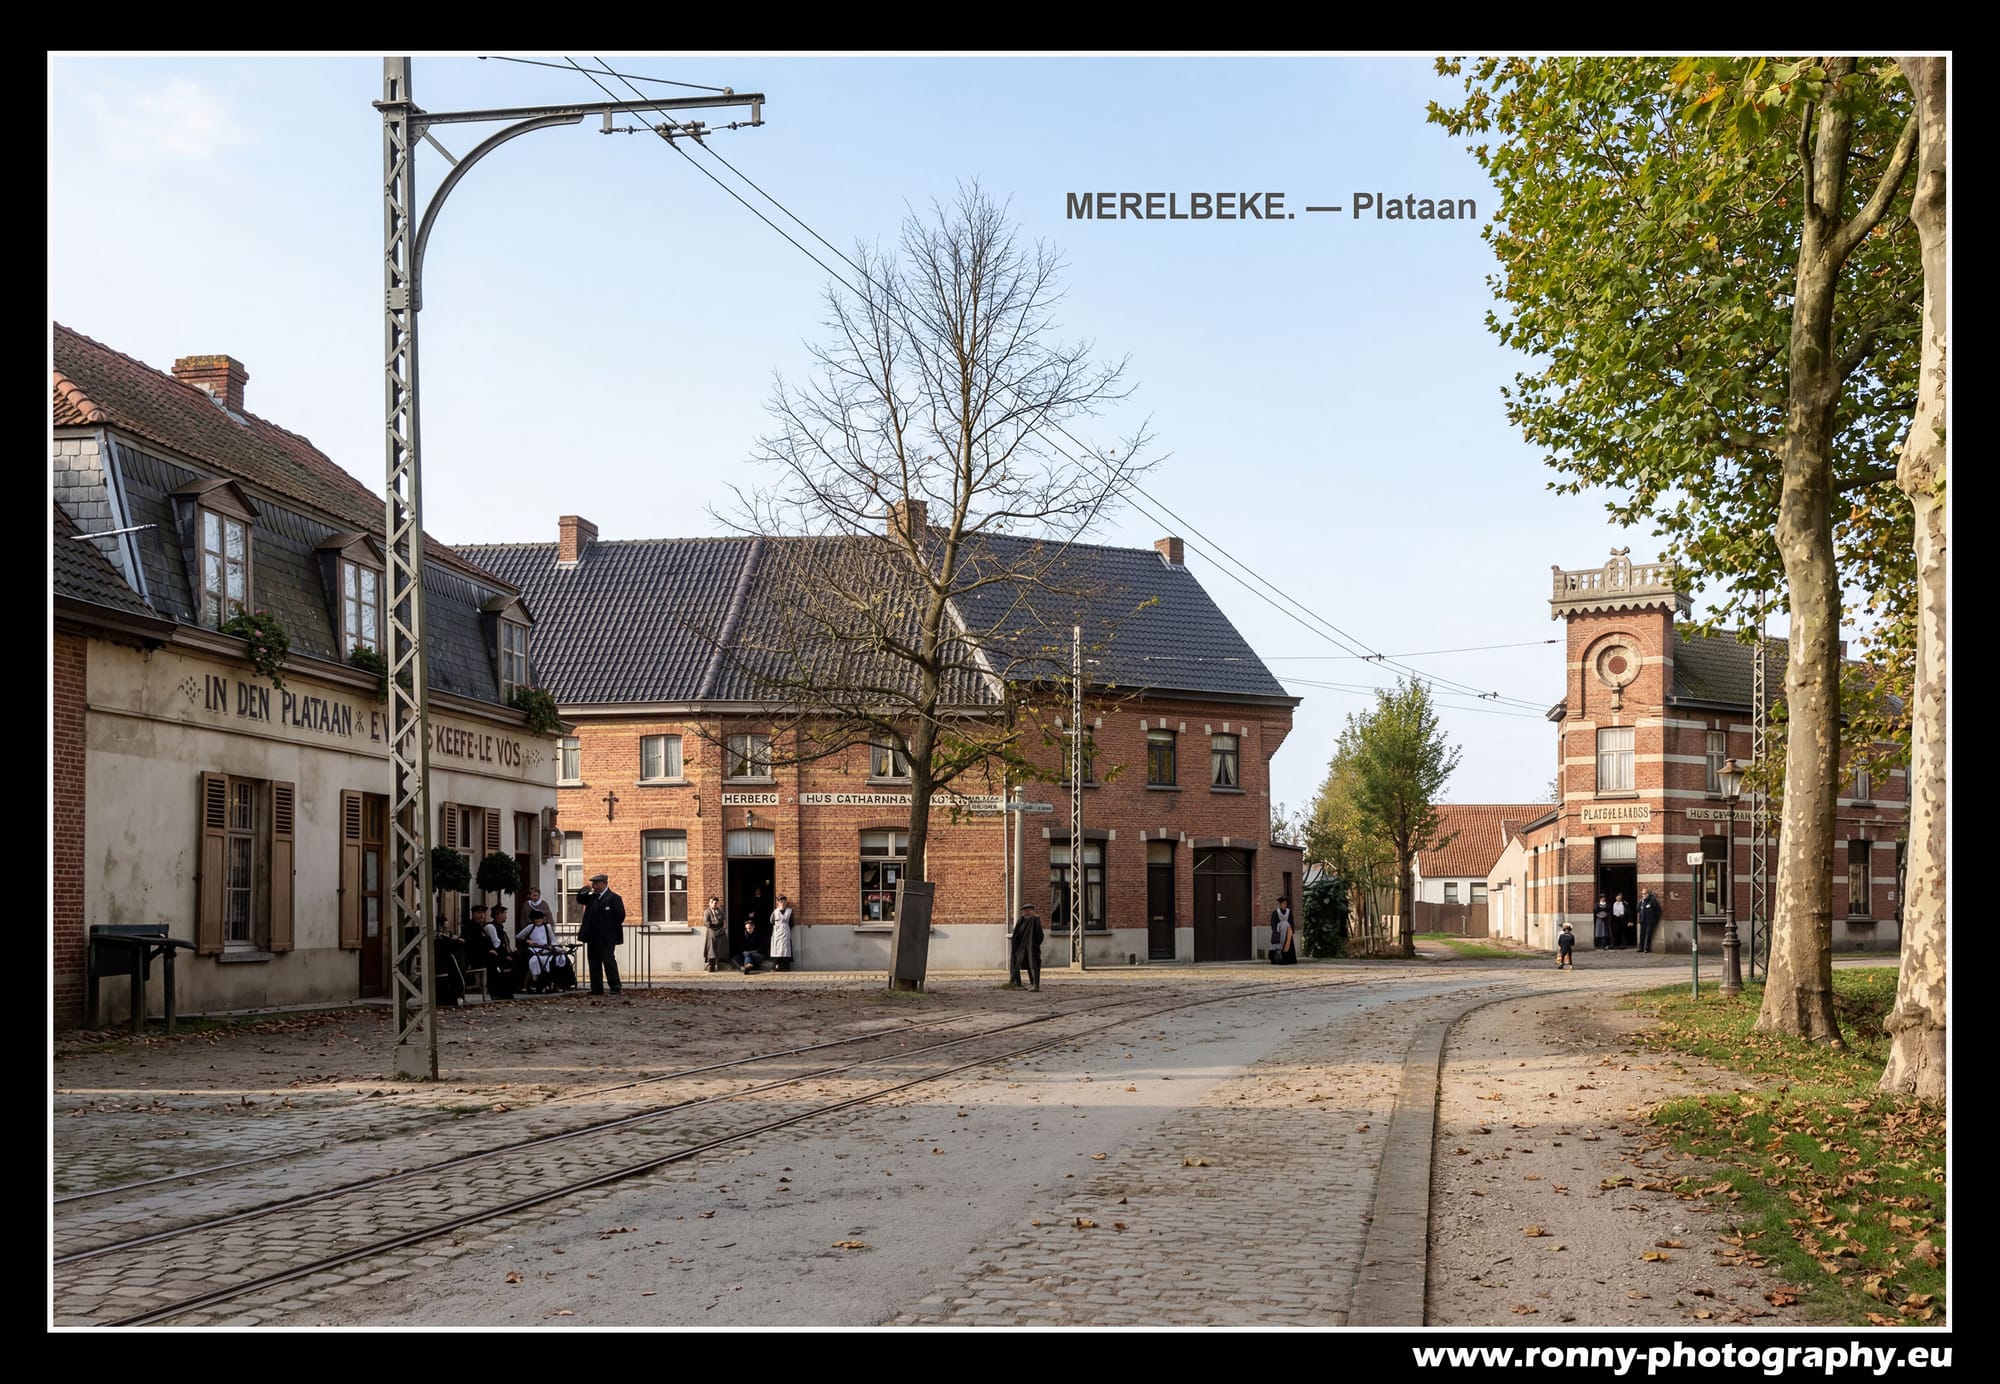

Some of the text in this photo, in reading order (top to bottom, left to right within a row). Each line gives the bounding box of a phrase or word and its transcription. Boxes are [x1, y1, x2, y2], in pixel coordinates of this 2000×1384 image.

[205, 674, 227, 713] IN
[237, 681, 270, 721] DEN
[281, 691, 352, 736] PLATAAN
[724, 794, 776, 804] HERBERG
[806, 794, 832, 804] HUS
